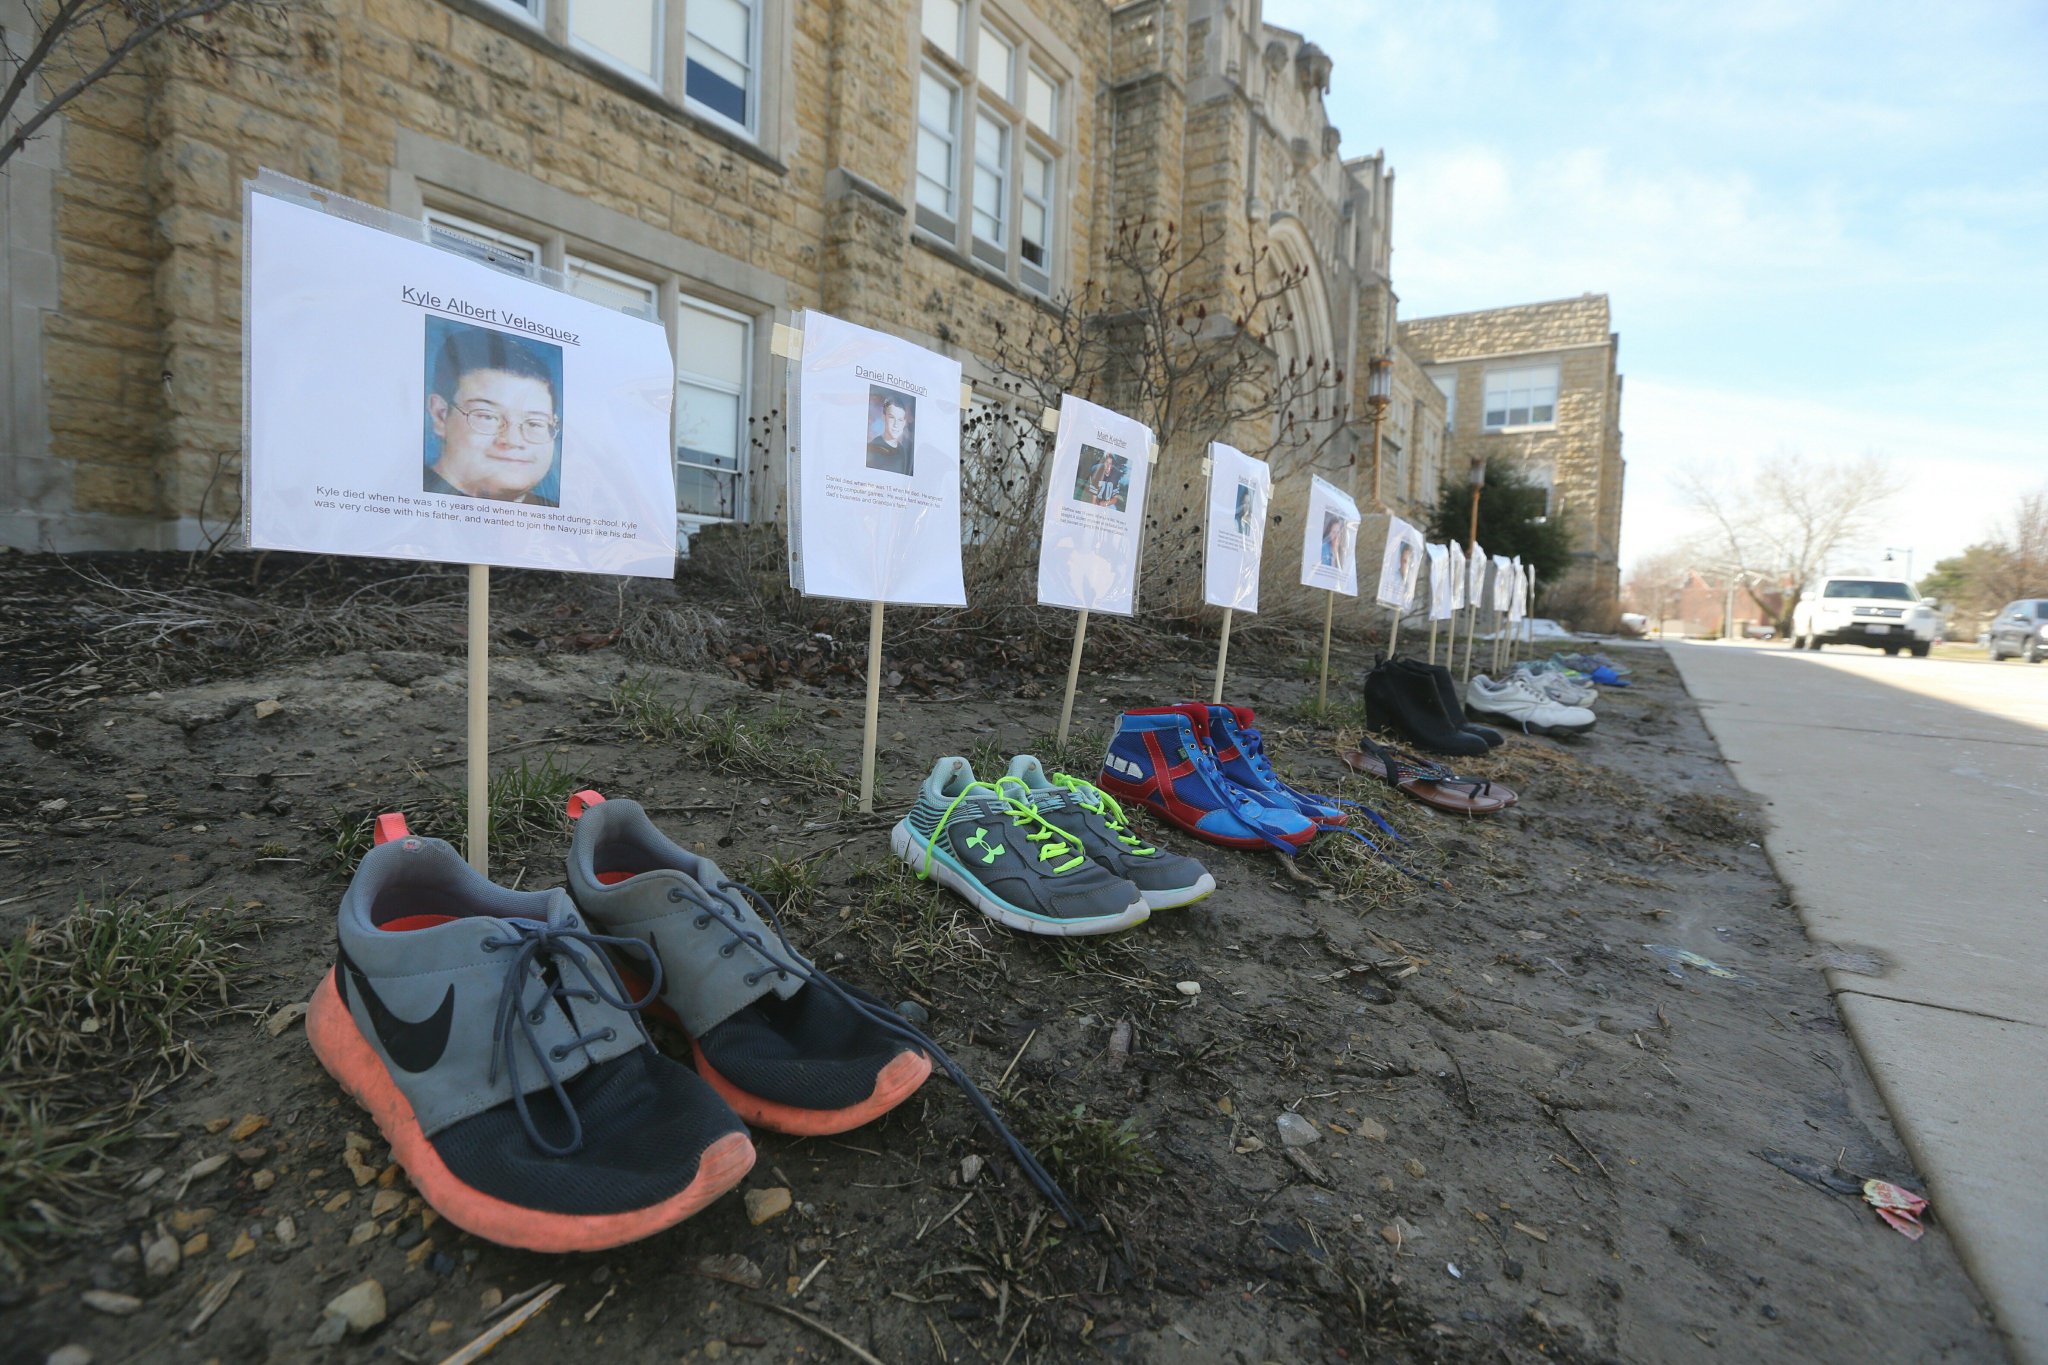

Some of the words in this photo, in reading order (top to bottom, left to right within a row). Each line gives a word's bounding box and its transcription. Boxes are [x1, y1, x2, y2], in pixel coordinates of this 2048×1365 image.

[402, 286, 441, 306] Kyle
[447, 298, 497, 321] Albert
[502, 311, 581, 344] Velasquez
[856, 366, 884, 381] Daniel
[887, 374, 928, 396] Rohrbough
[826, 484, 843, 492] playing
[844, 487, 866, 495] computer
[840, 494, 861, 502] business
[314, 500, 336, 509] was
[339, 503, 361, 513] very
[364, 505, 391, 514] close
[394, 507, 413, 517] with
[416, 510, 430, 518] his
[433, 511, 462, 522] father,
[464, 515, 481, 523] and
[483, 517, 515, 527] wanted
[516, 520, 525, 528] to
[526, 522, 541, 530] join
[543, 523, 556, 532] the
[558, 525, 577, 535] Navy
[579, 527, 593, 536] just
[595, 528, 608, 536] like
[609, 530, 621, 538] his
[622, 532, 638, 540] dad.
[316, 486, 340, 497] Kyle
[343, 489, 365, 499] died
[368, 492, 395, 503] when
[398, 495, 410, 504] he
[413, 498, 432, 507] was
[436, 499, 447, 508] 16
[449, 503, 475, 512] years
[477, 505, 490, 513] old
[493, 507, 515, 516] when
[518, 509, 528, 518] he
[530, 512, 546, 520] was
[548, 513, 565, 522] shot
[567, 515, 591, 526] during
[593, 519, 619, 528] school.
[621, 521, 638, 530] Kyle
